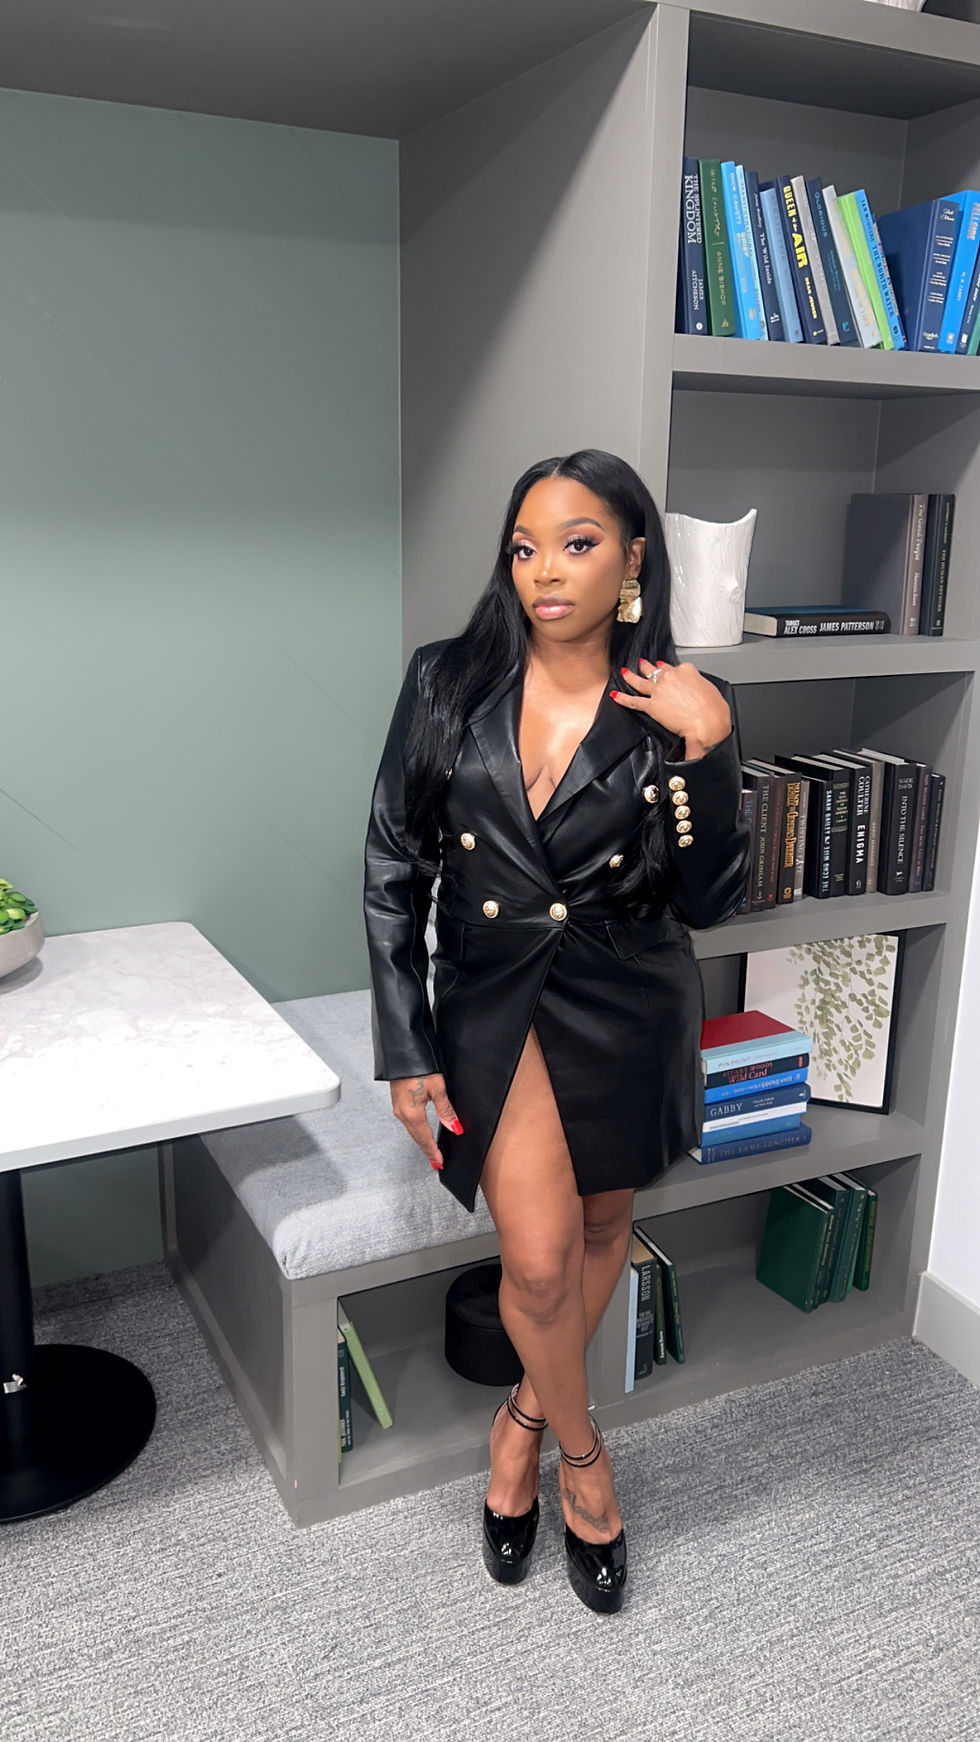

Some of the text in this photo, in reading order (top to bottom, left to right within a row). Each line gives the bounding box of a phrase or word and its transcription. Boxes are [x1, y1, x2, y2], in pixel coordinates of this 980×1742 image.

[684, 176, 695, 243] KINGDOM
[694, 193, 702, 243] SPLINTERED
[784, 186, 797, 217] QUEEN
[793, 232, 808, 268] AIR
[761, 247, 769, 263] Wild
[871, 244, 881, 261] THE
[764, 264, 773, 284] Inside
[875, 262, 888, 290] NORTH
[691, 269, 699, 310] AITCHESON
[718, 276, 726, 305] BISHOP
[883, 290, 896, 317] WATER
[783, 625, 798, 634] ALEX
[798, 625, 818, 634] CROSS
[818, 622, 839, 631] JAMES
[839, 620, 874, 631] PATTERSON
[857, 776, 865, 815] COULTER
[900, 795, 908, 815] INTO
[797, 814, 805, 854] TWISTING
[855, 825, 865, 863] ENIGMA
[897, 832, 905, 864] SILENCE
[823, 845, 831, 861] WIFE
[722, 1062, 773, 1077] STUART WOODS
[727, 1073, 748, 1084] Wild
[747, 1069, 768, 1079] Card
[709, 1103, 744, 1117] GABBY
[641, 1265, 651, 1301] LARSSON
